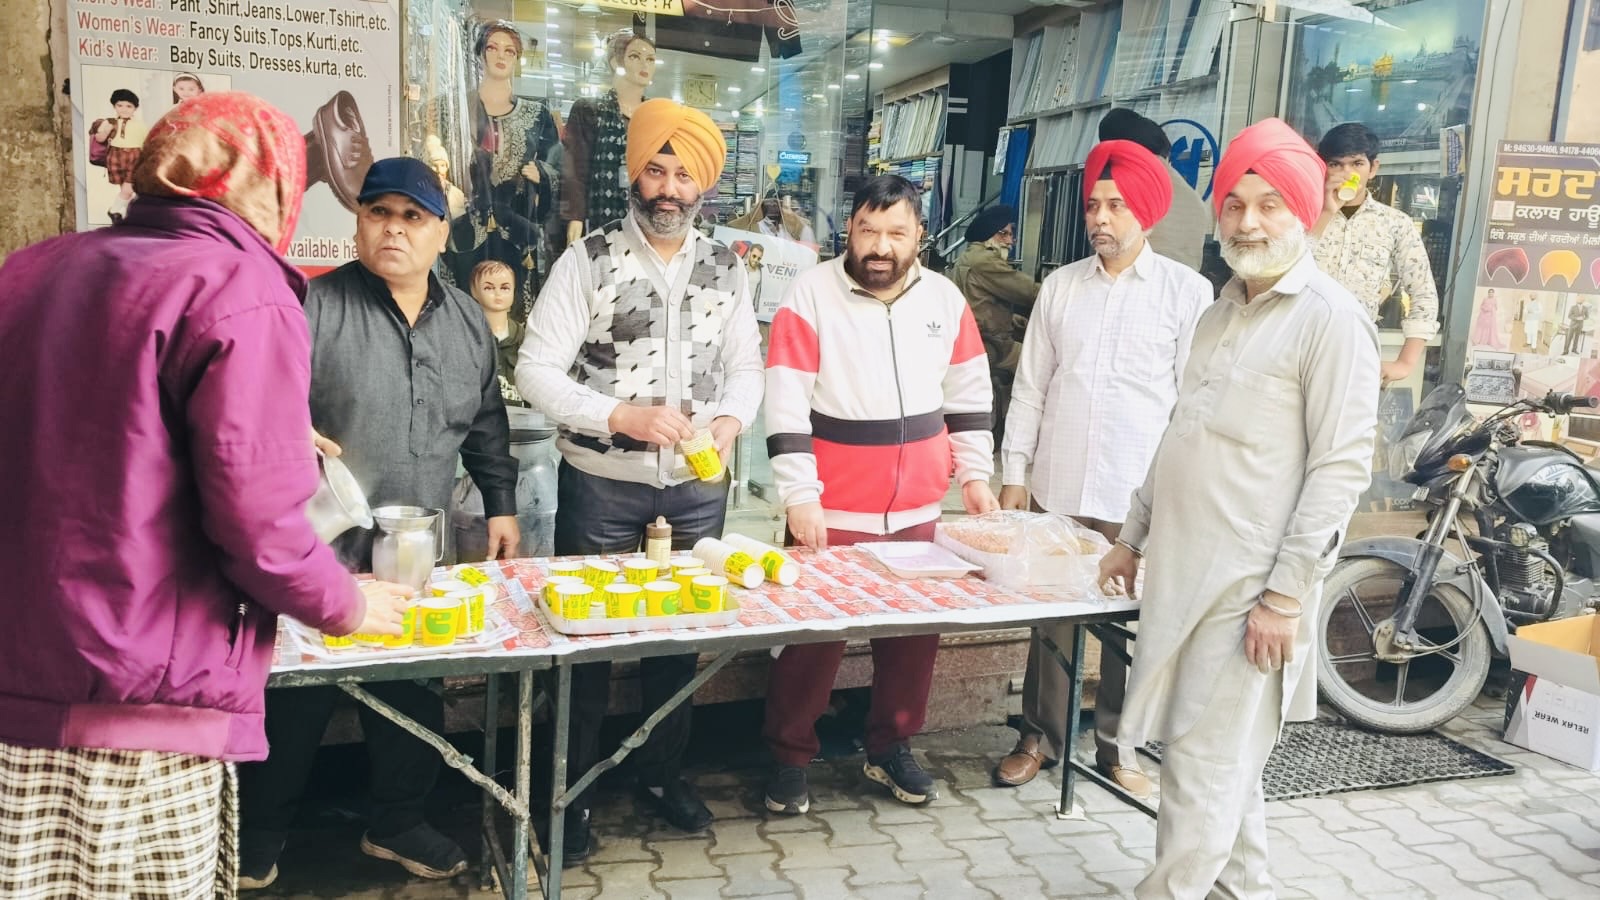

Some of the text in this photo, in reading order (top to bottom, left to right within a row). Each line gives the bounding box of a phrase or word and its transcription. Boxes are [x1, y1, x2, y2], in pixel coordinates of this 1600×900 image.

[170, 0, 202, 13] Pant
[77, 11, 142, 35] Women's
[146, 16, 185, 38] Wear:
[190, 21, 229, 46] Fancy
[79, 37, 114, 59] Kid's
[118, 42, 158, 62] Wear:
[170, 45, 203, 70] Baby
[208, 48, 245, 70] Suits,
[345, 62, 367, 79] etc.
[1497, 166, 1600, 200] ਸਰਦ
[1515, 205, 1563, 221] ਕਲਾਥ
[287, 238, 360, 259] vailable he
[1534, 710, 1590, 735] RELAX WEAR
